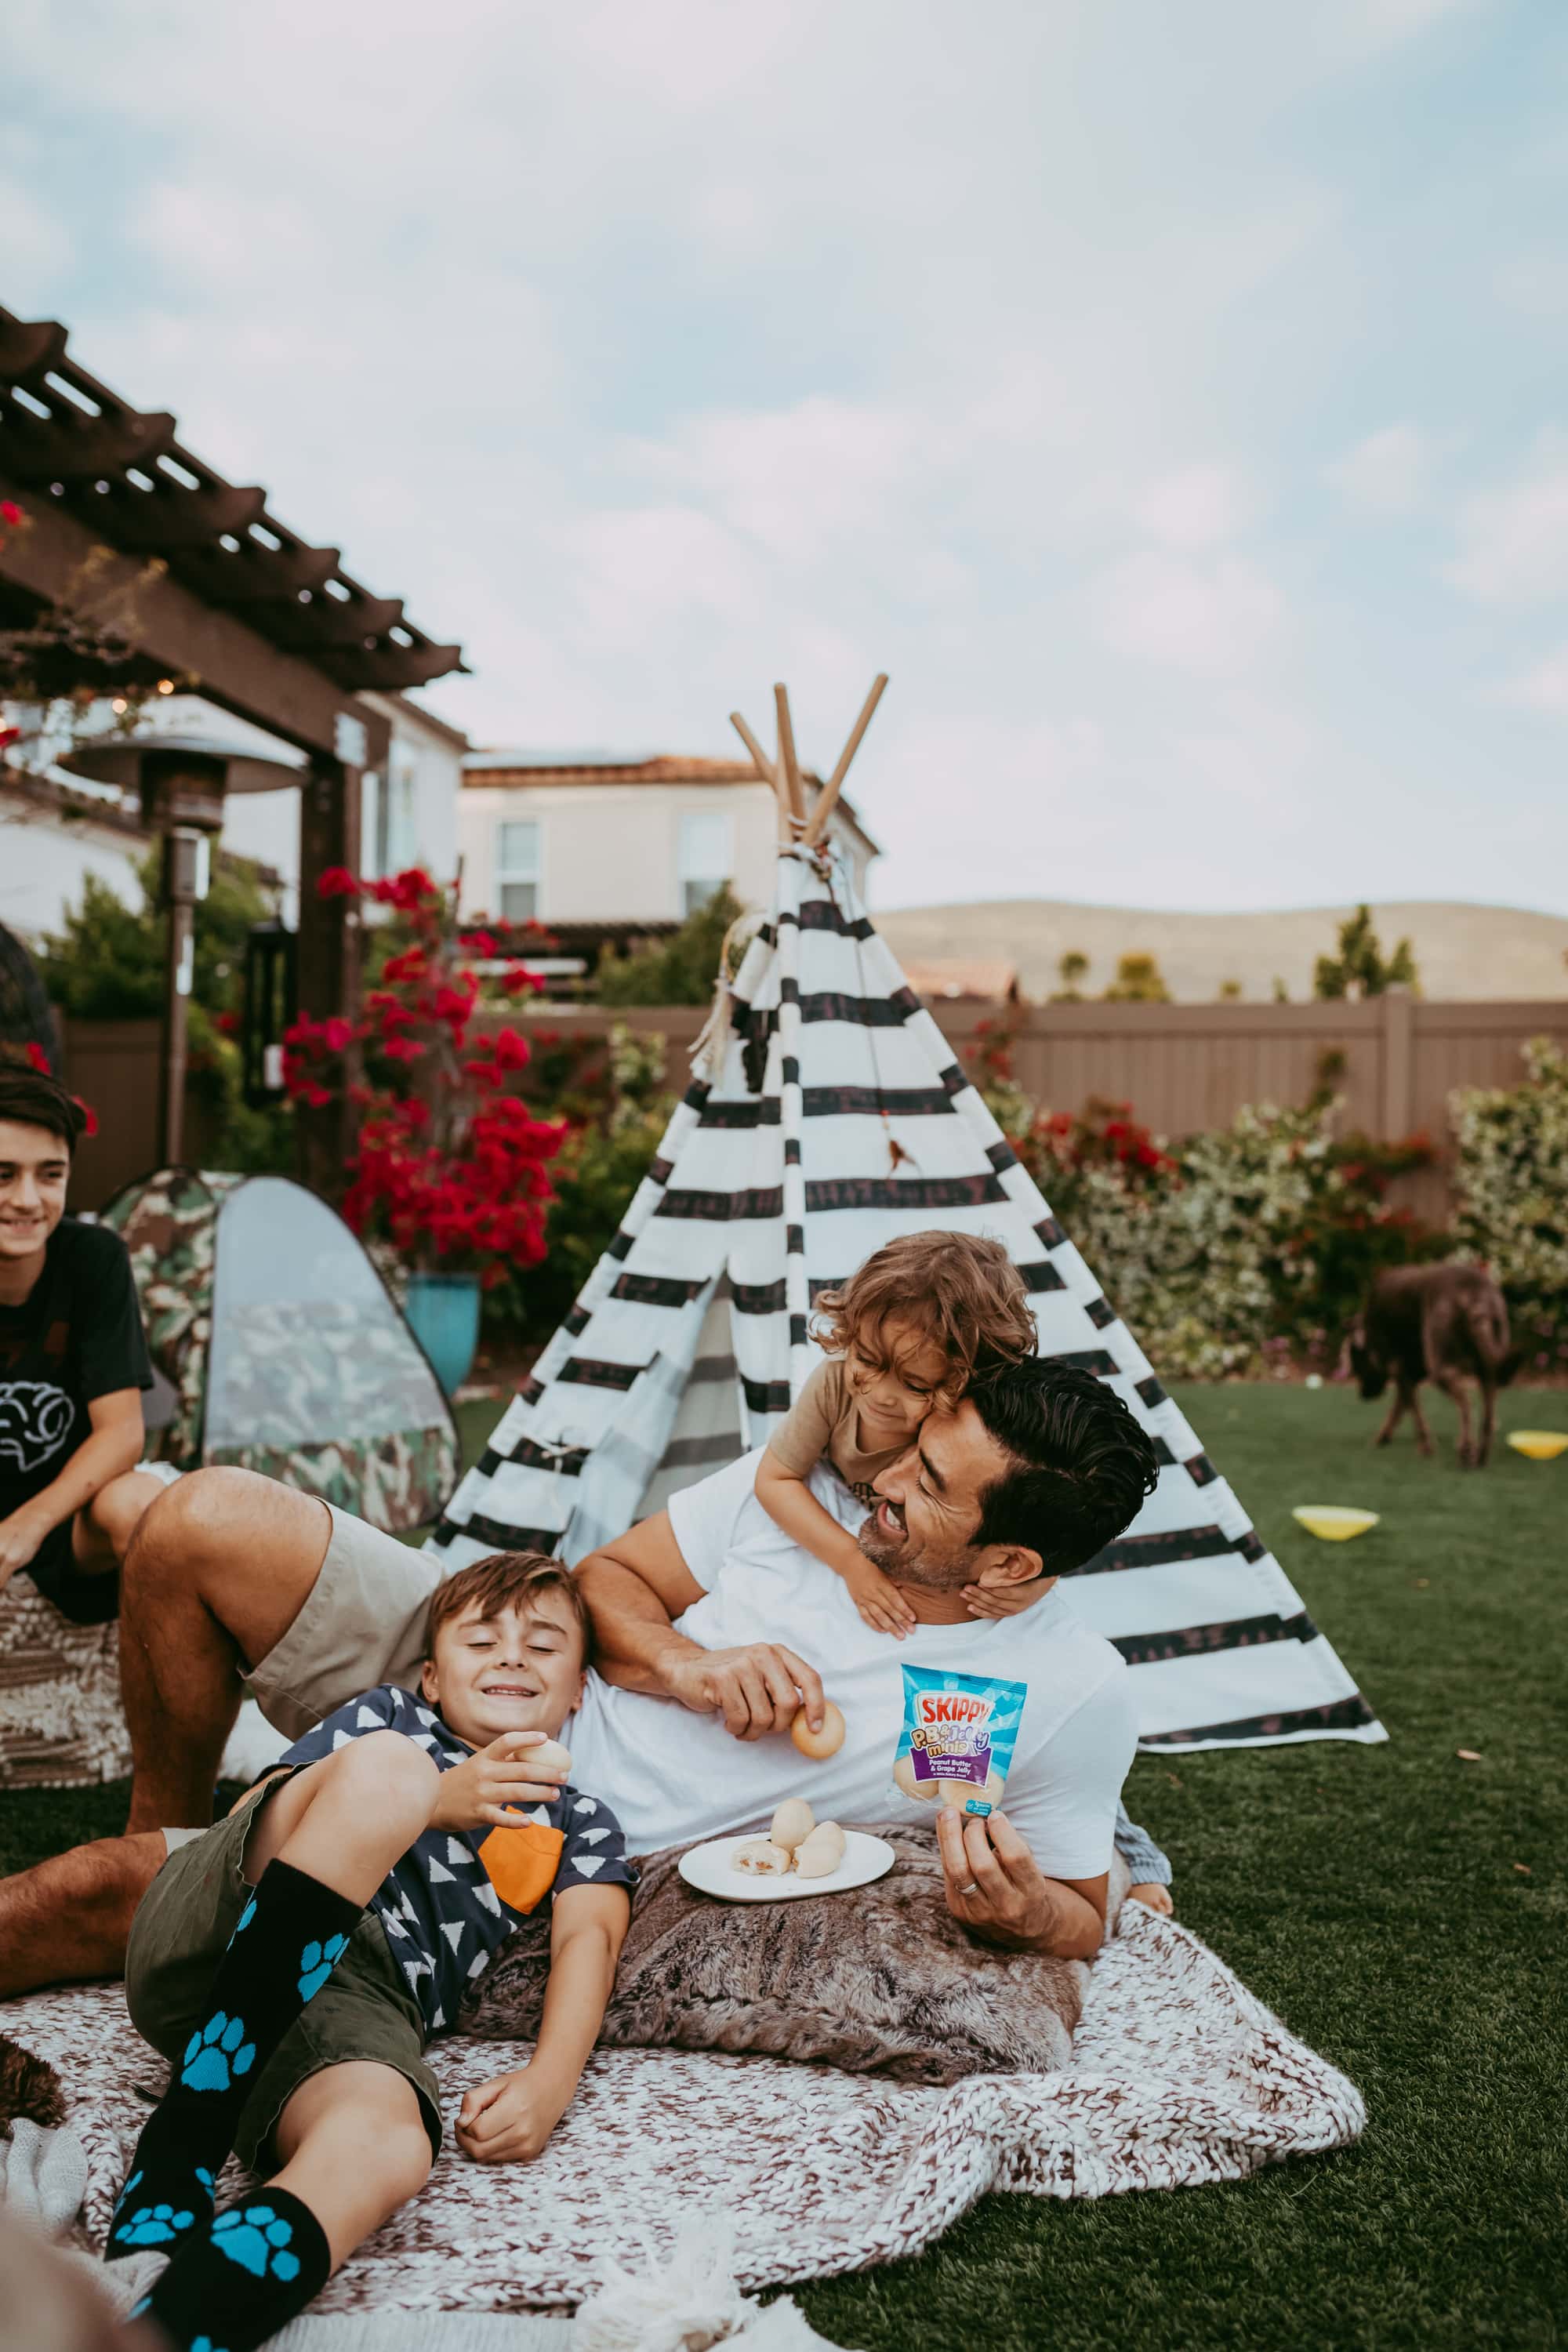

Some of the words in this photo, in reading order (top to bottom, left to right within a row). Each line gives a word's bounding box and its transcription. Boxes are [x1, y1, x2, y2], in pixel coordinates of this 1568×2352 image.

[923, 1697, 989, 1723] SKIPPY
[948, 1726, 989, 1750] Jely
[927, 1740, 967, 1757] minis
[956, 1766, 971, 1775] Jelly
